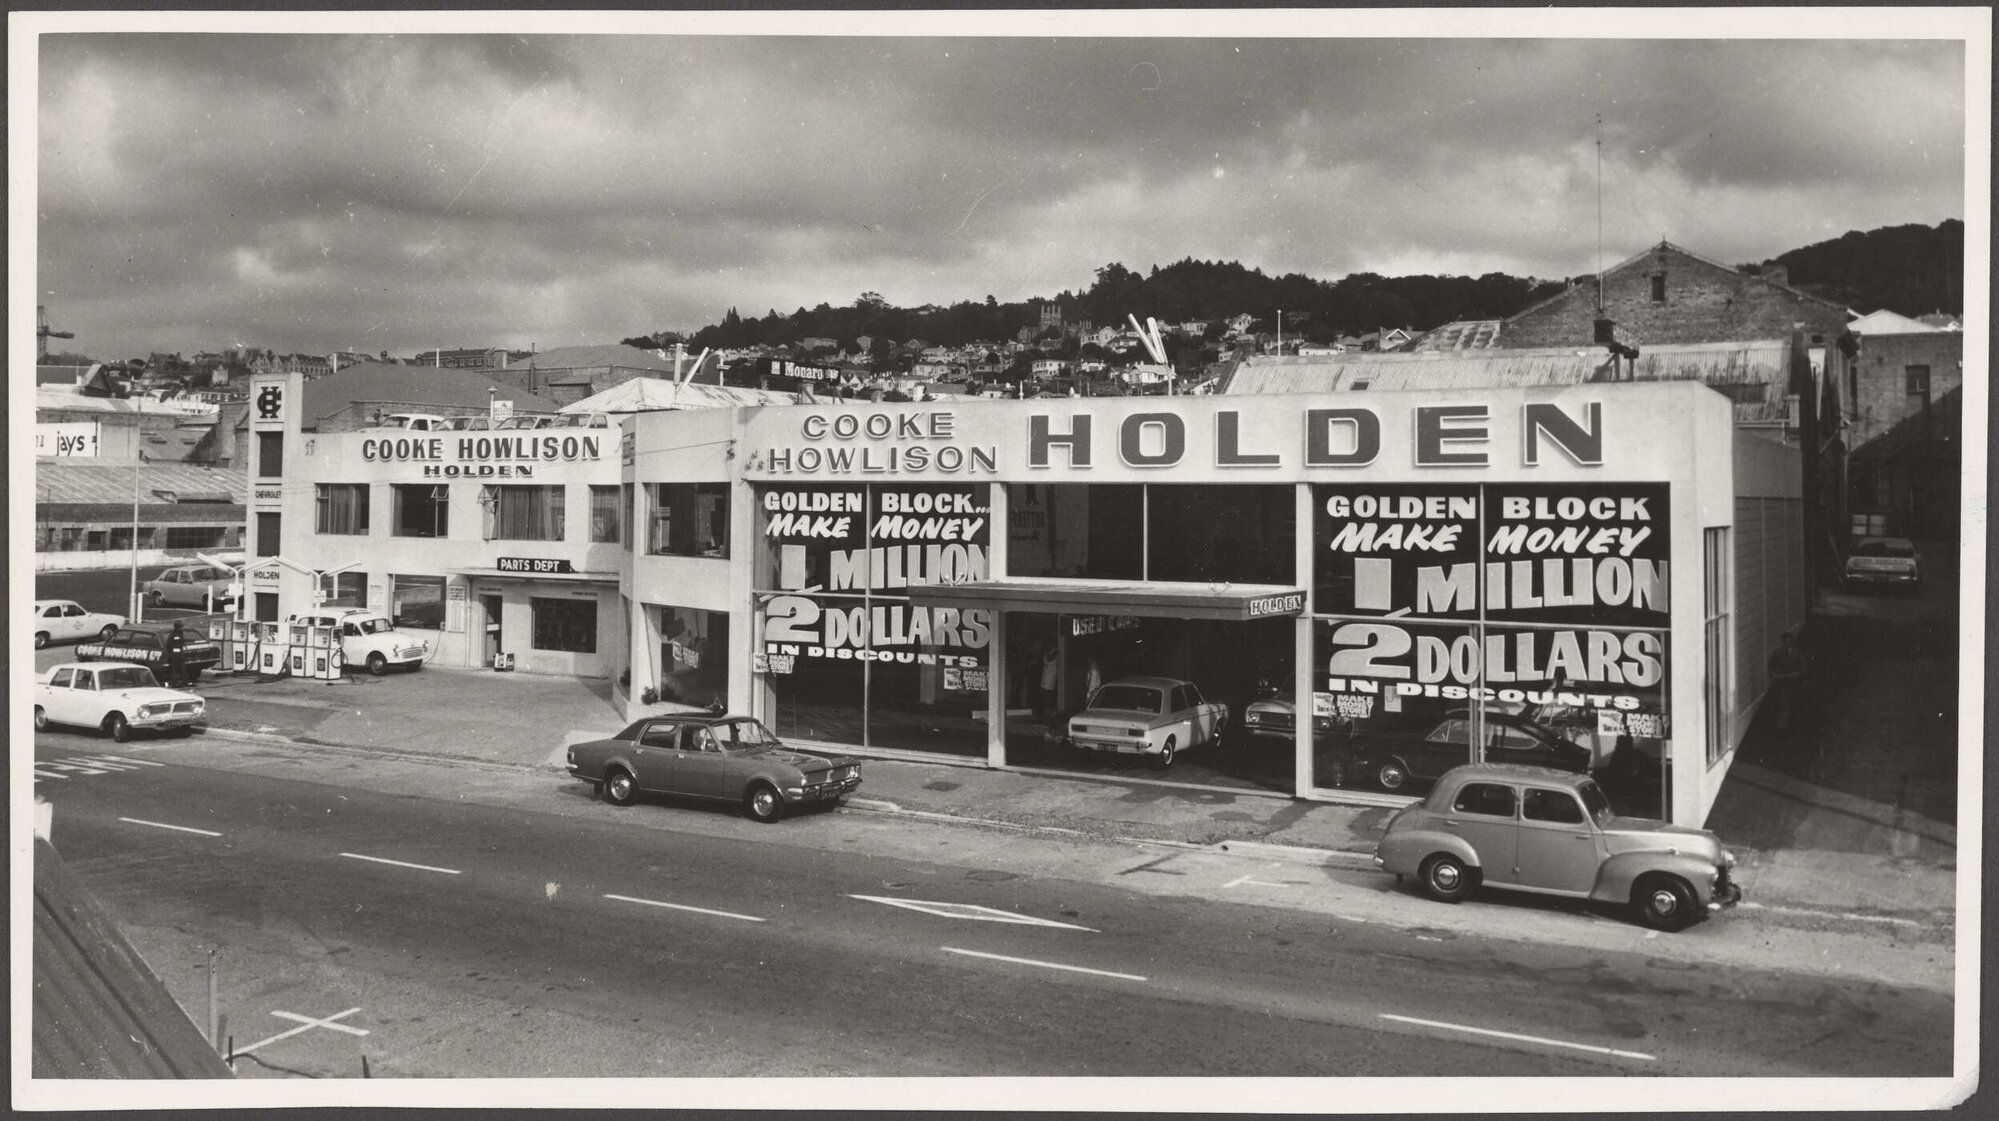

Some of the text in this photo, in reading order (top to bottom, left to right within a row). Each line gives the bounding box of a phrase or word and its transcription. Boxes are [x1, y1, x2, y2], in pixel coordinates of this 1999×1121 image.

[784, 361, 823, 380] Monaro
[802, 411, 955, 440] COOKE
[1028, 401, 1604, 469] HOLDEN
[56, 431, 85, 456] jays
[362, 437, 444, 461] COOKE
[458, 435, 600, 461] HOWLISON
[423, 464, 534, 477] HOLDEN
[768, 444, 998, 475] HOWLISON
[764, 492, 862, 513] GOLDEN
[1326, 495, 1651, 521] GOLDEN BLOCK
[765, 513, 851, 539] MAKE
[870, 516, 984, 540] MONEY
[1330, 523, 1651, 556] MAKE MONEY
[254, 571, 280, 580] HOLDEN
[500, 558, 560, 573] PARTS DEPT
[829, 544, 990, 591] MILLION
[1416, 557, 1669, 614] MILLION
[1250, 594, 1302, 615] HOLDEN
[824, 605, 990, 648] DOLLARS
[77, 645, 103, 656] COOKE
[104, 646, 148, 660] HOWLISON
[767, 643, 978, 668] IN DISCOUNTS
[1416, 630, 1662, 687] DOLLARS
[1329, 679, 1640, 710] IN DISCOUNTS
